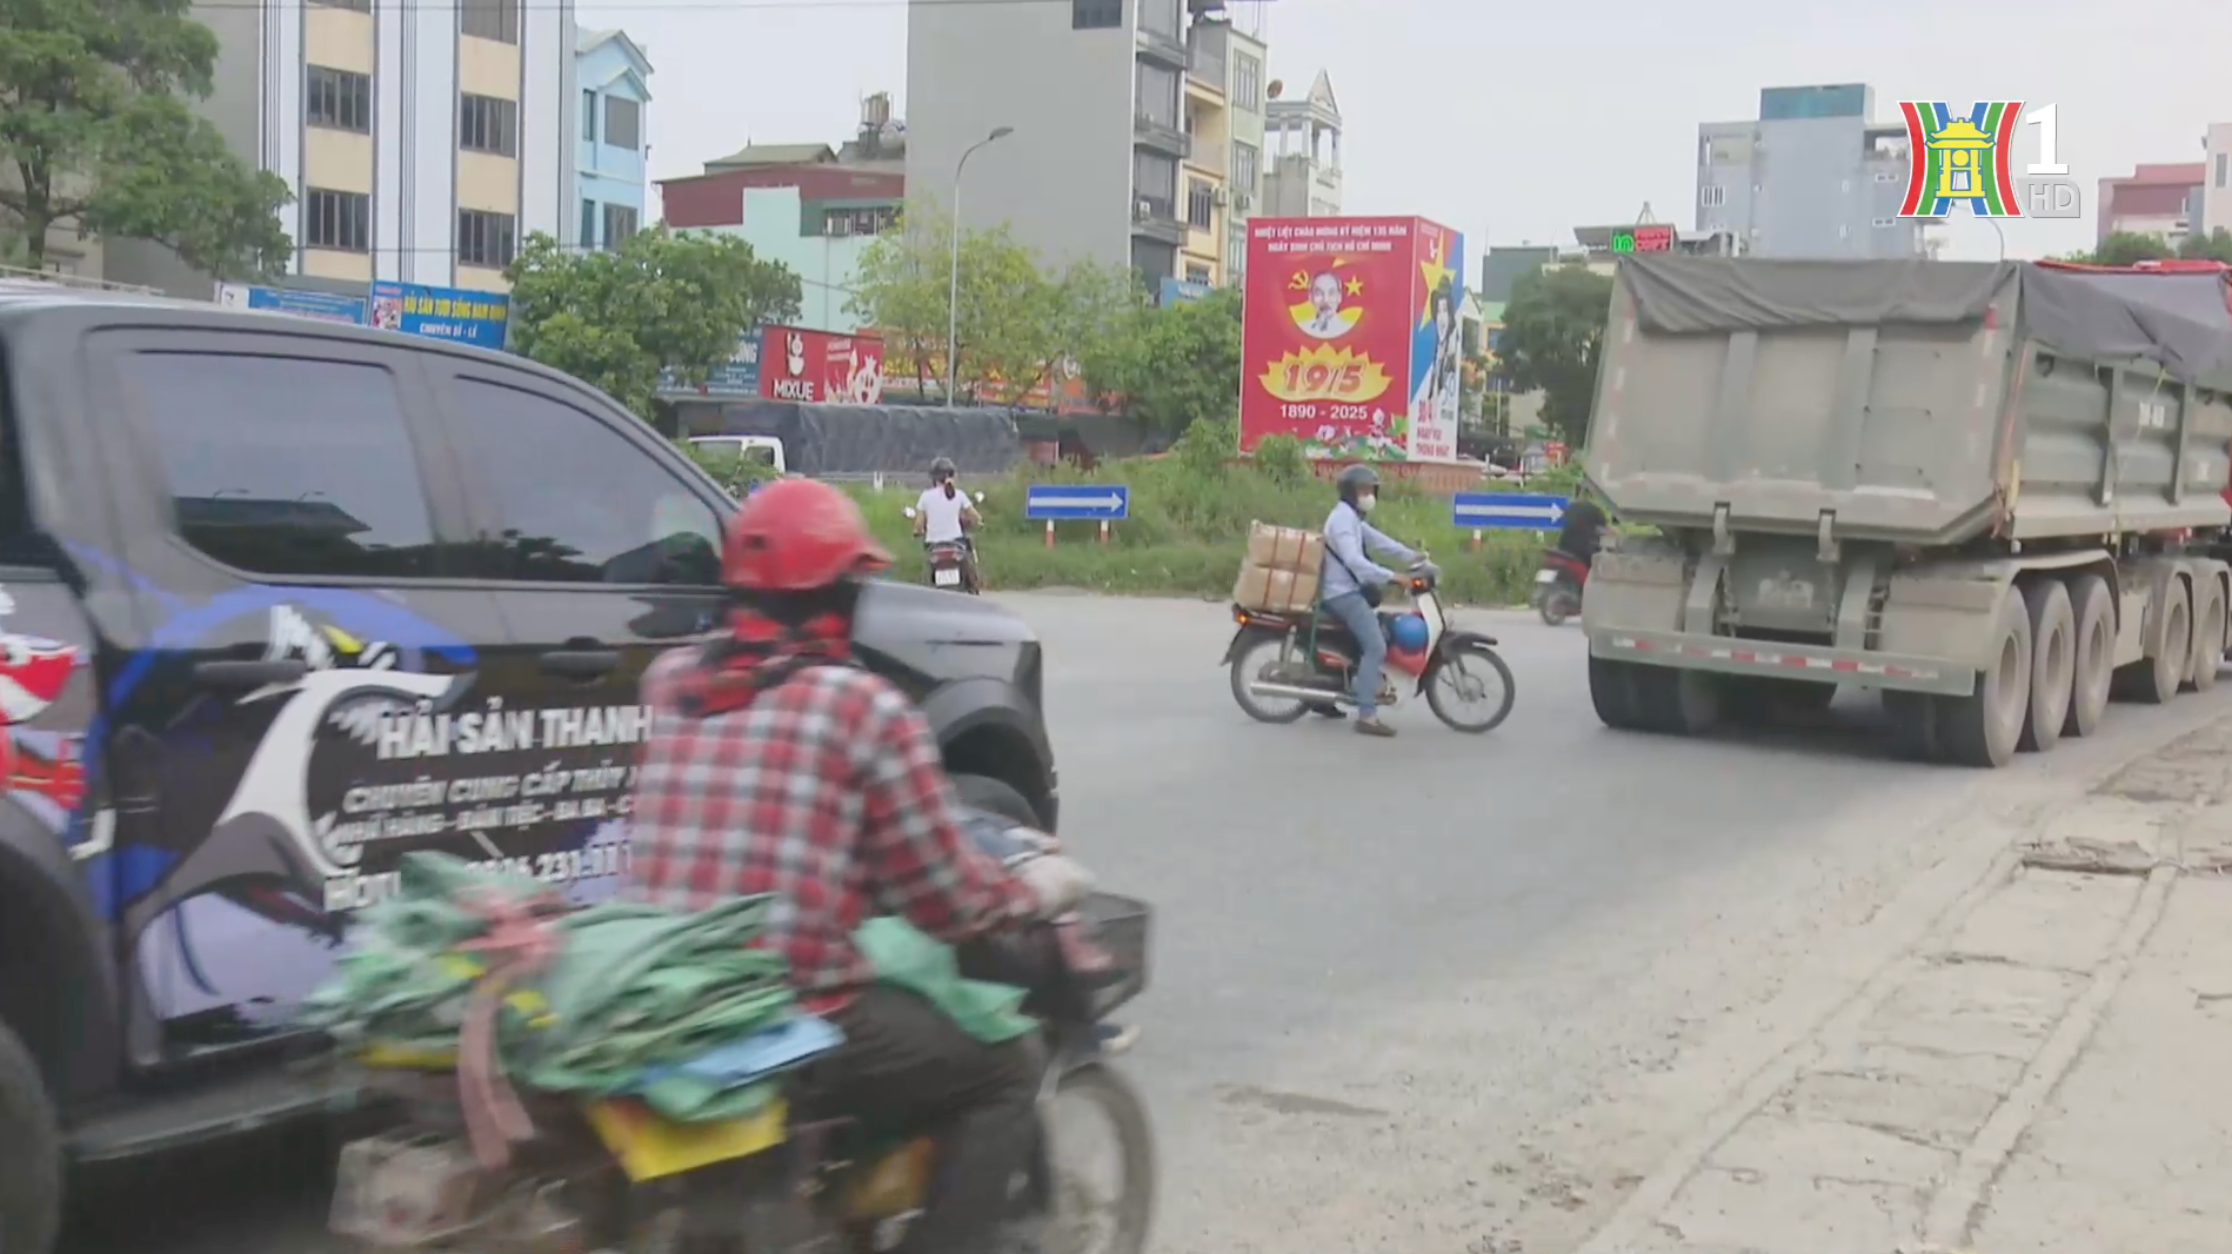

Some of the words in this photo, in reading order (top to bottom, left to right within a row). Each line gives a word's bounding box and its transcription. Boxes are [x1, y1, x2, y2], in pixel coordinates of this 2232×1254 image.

[773, 378, 814, 400] MIXUE
[1284, 363, 1363, 394] 19/5
[1280, 404, 1316, 419] 1890
[1330, 404, 1368, 420] 2025
[377, 699, 449, 760] HẢI
[456, 696, 536, 754] SẢN
[342, 775, 447, 814] CHUYÊN
[447, 775, 520, 804] CUNG
[520, 759, 571, 797] CẤP
